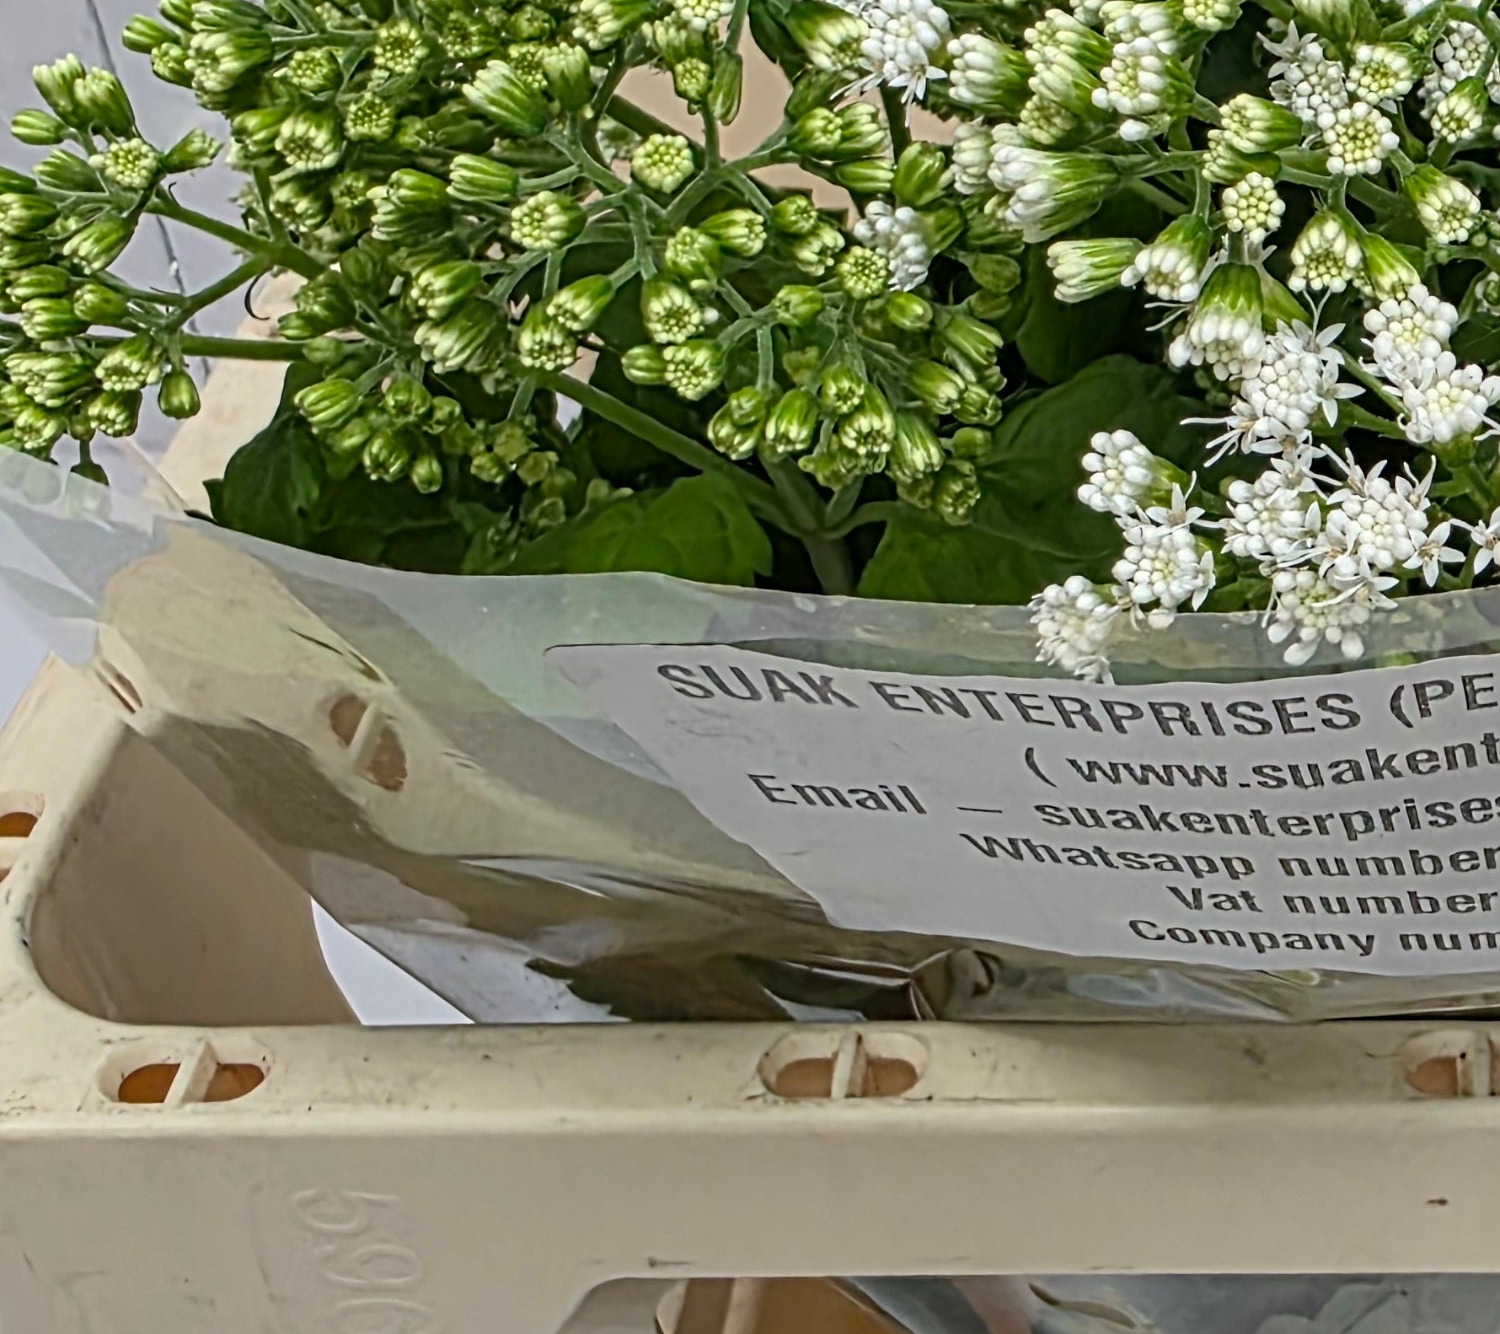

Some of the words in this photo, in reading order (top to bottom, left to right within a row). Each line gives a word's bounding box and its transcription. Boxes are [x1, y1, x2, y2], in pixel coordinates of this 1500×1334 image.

[656, 663, 859, 708] SUAK
[871, 680, 1361, 737] ENTERPRISES
[748, 774, 926, 814] Email
[958, 832, 1254, 880] Whatsapp
[1166, 884, 1259, 914] Vat
[1284, 886, 1498, 914] number
[1127, 918, 1376, 957] Company
